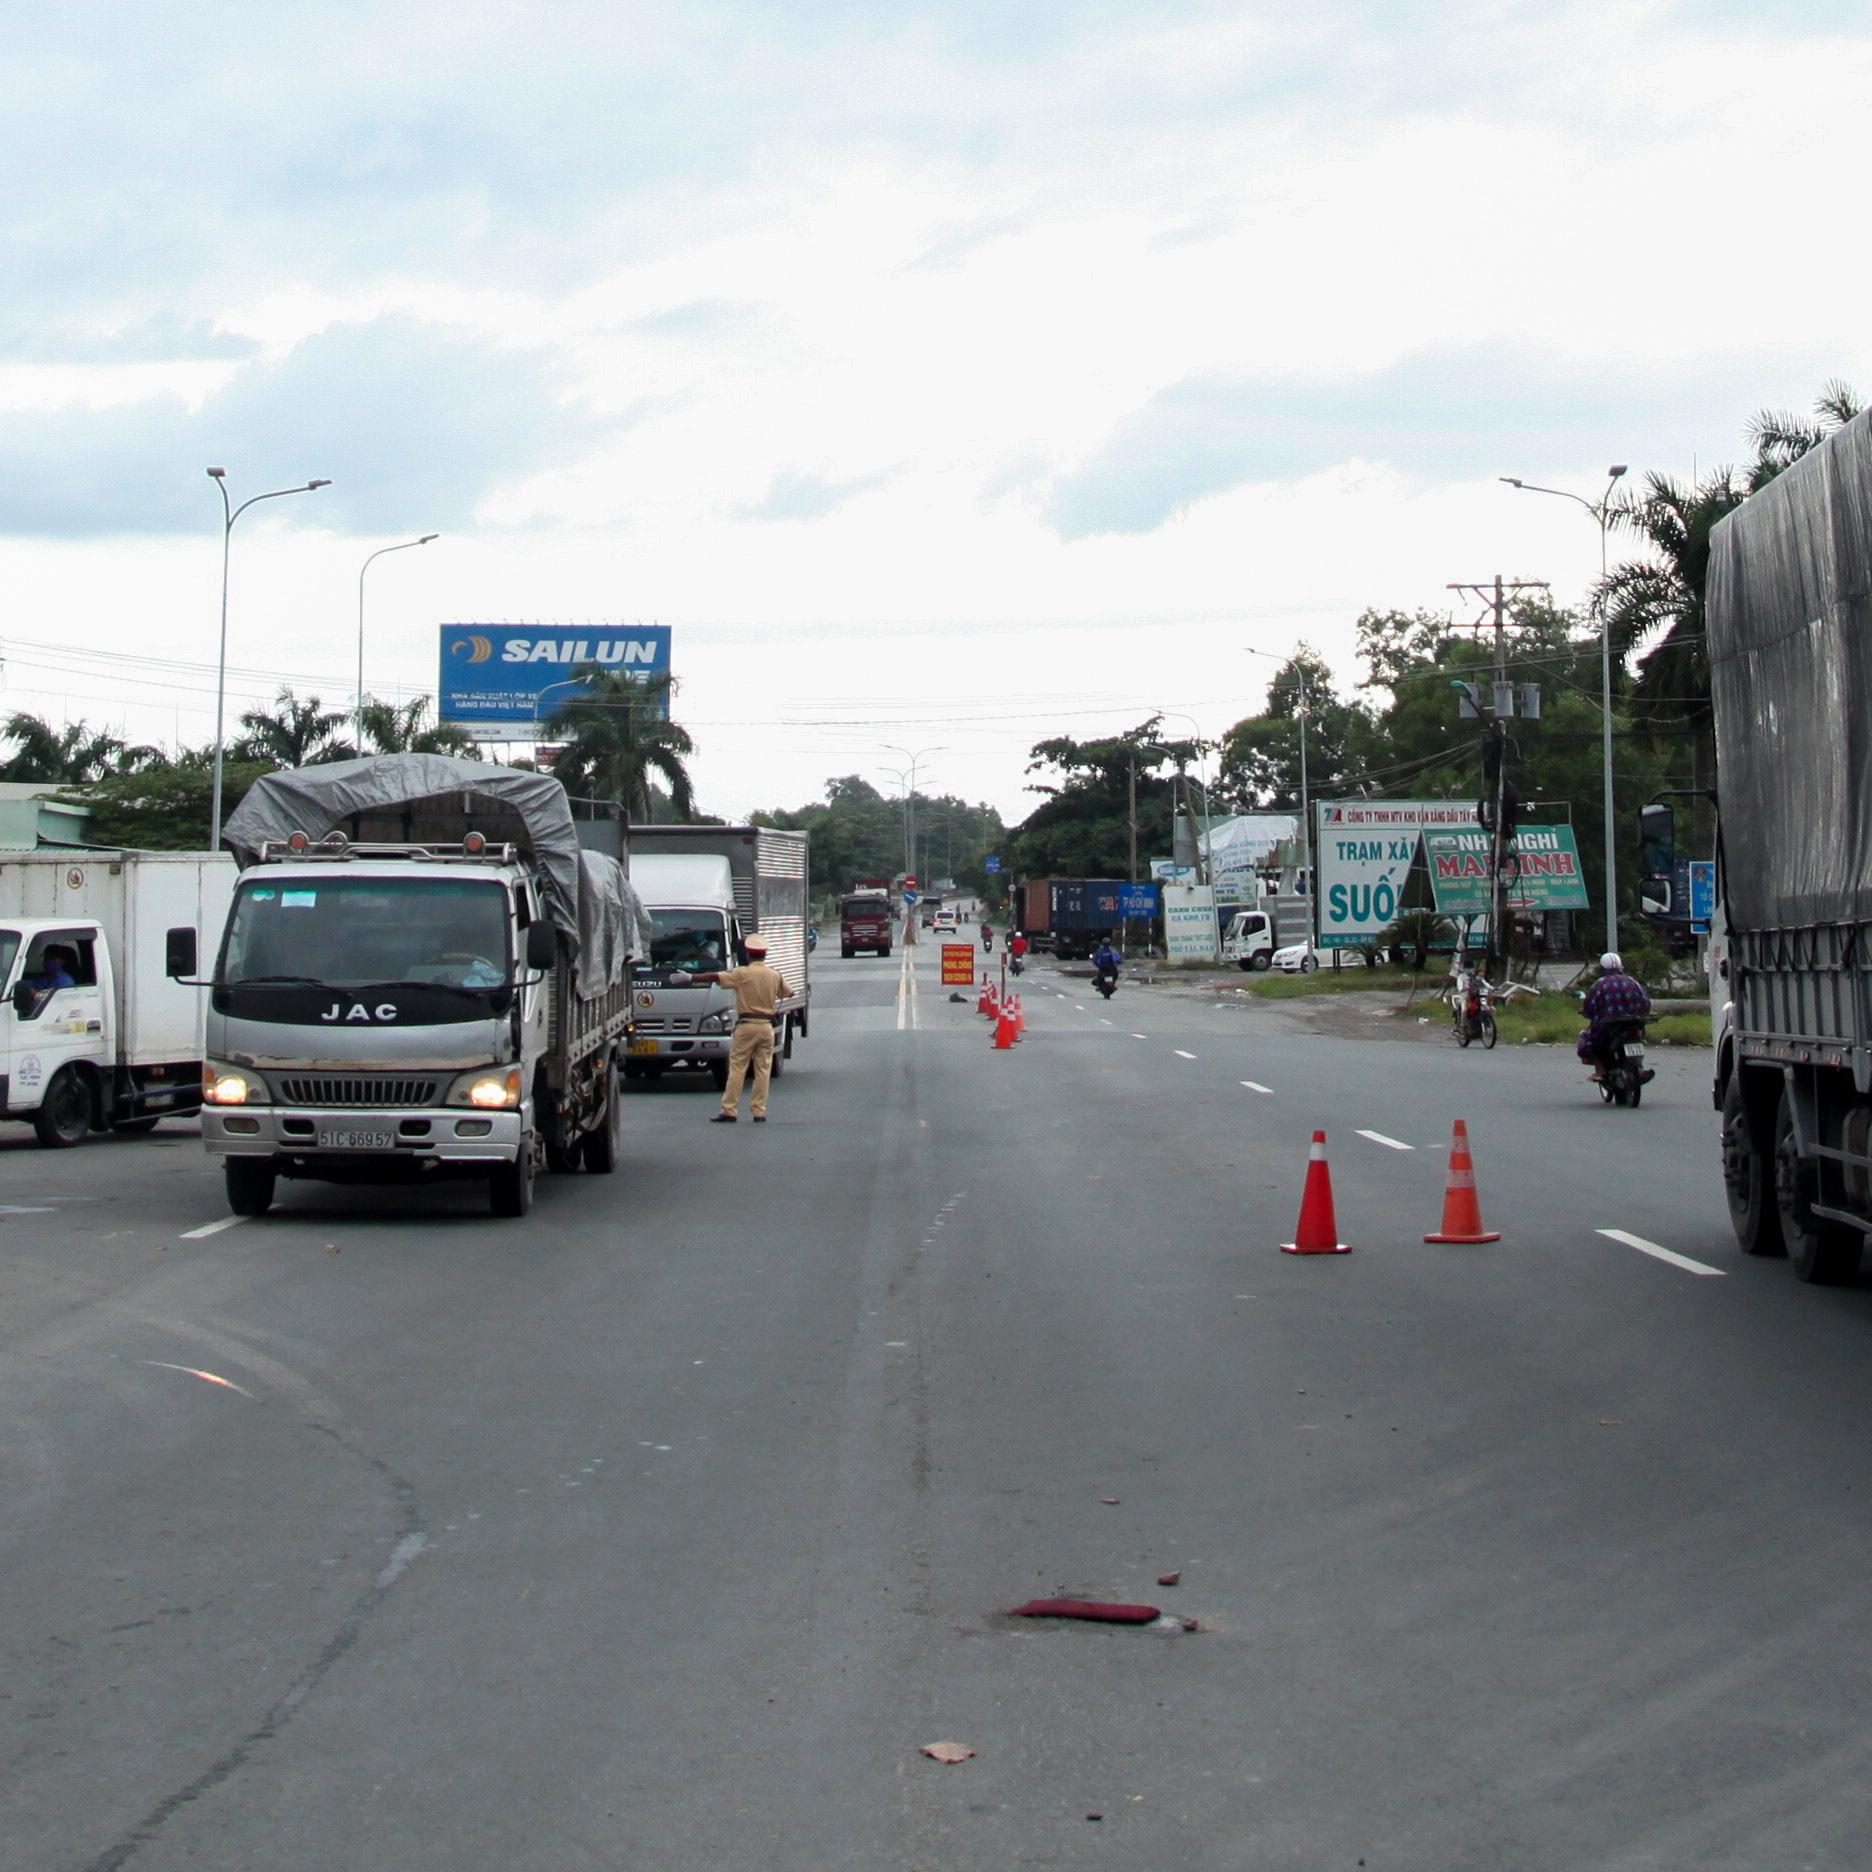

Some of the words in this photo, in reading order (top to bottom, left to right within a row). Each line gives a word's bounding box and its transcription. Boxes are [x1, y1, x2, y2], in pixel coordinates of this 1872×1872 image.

[502, 639, 658, 664] SAILUN
[1457, 834, 1495, 851] NH
[1336, 841, 1382, 866] TRẠM
[321, 1003, 398, 1021] JAC
